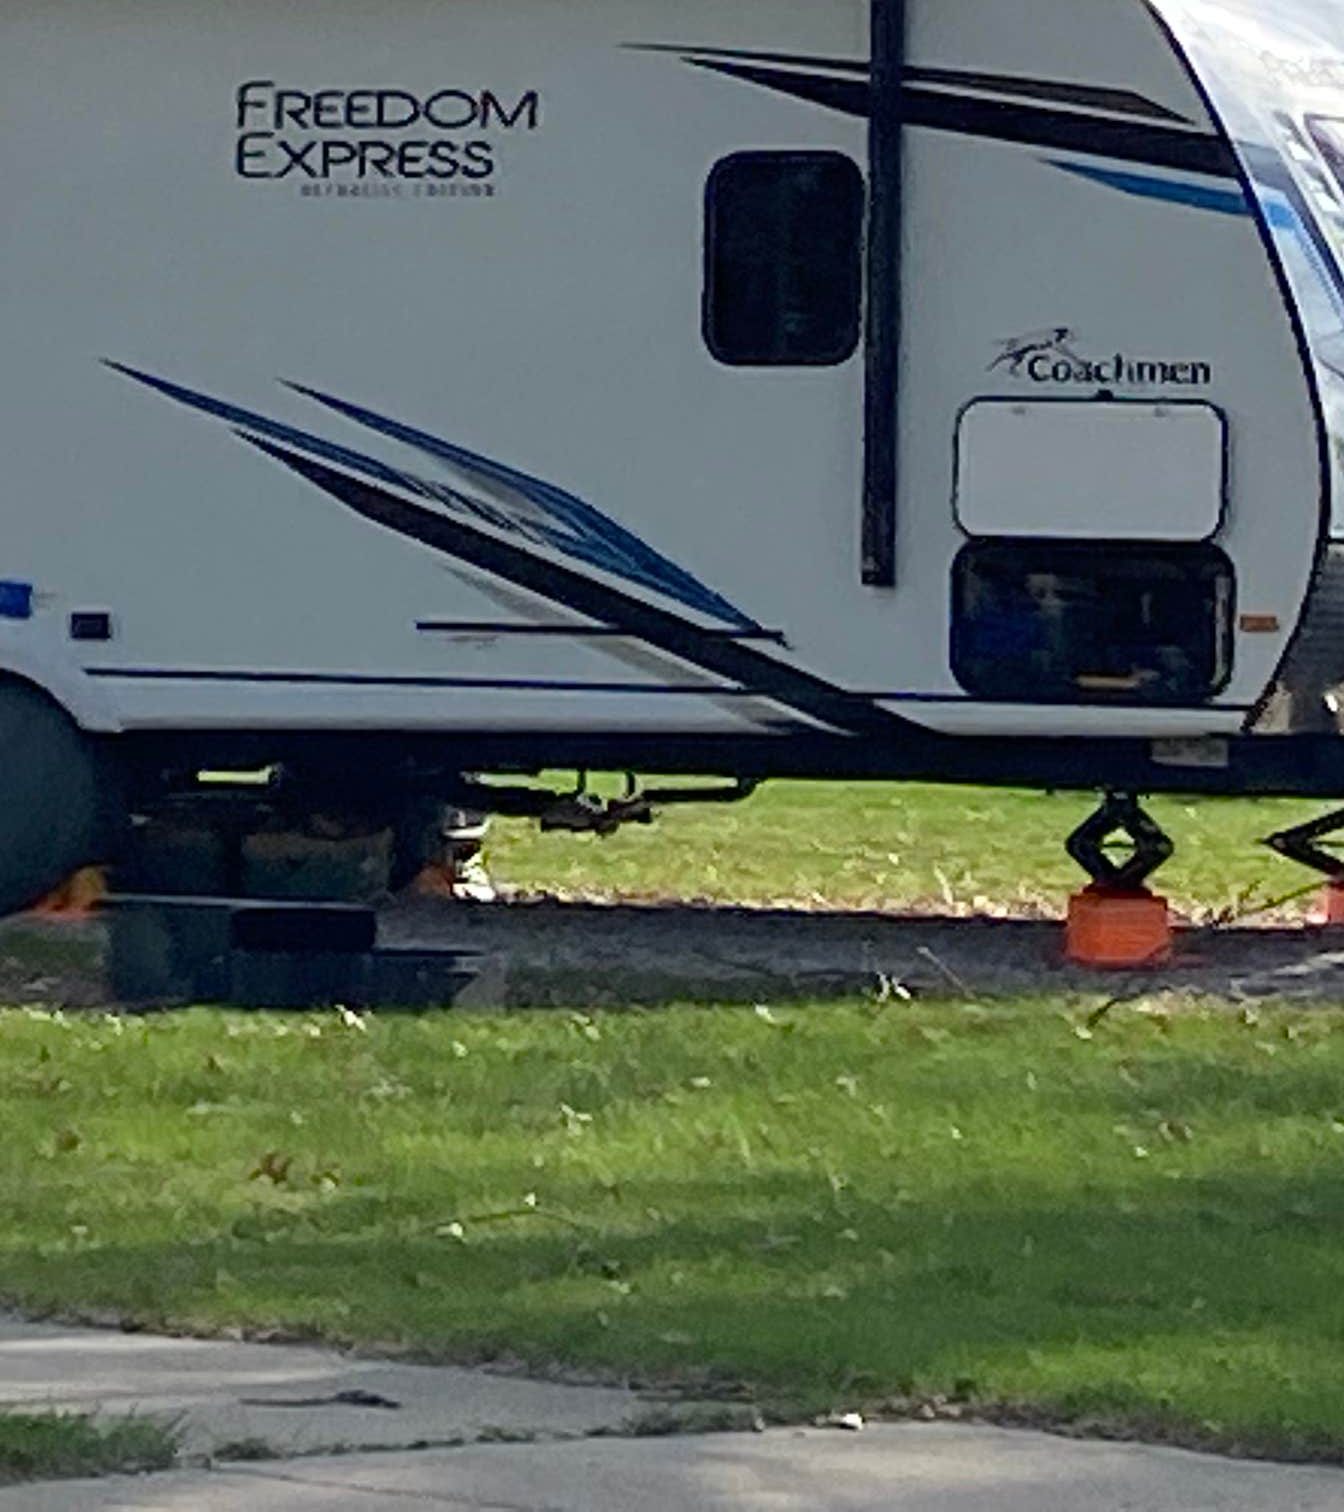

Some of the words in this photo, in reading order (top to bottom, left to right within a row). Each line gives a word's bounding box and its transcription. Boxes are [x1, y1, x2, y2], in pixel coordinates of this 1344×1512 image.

[236, 81, 538, 128] FREEDOM
[236, 131, 494, 178] EXPRESS
[1027, 353, 1211, 384] Coachmen
